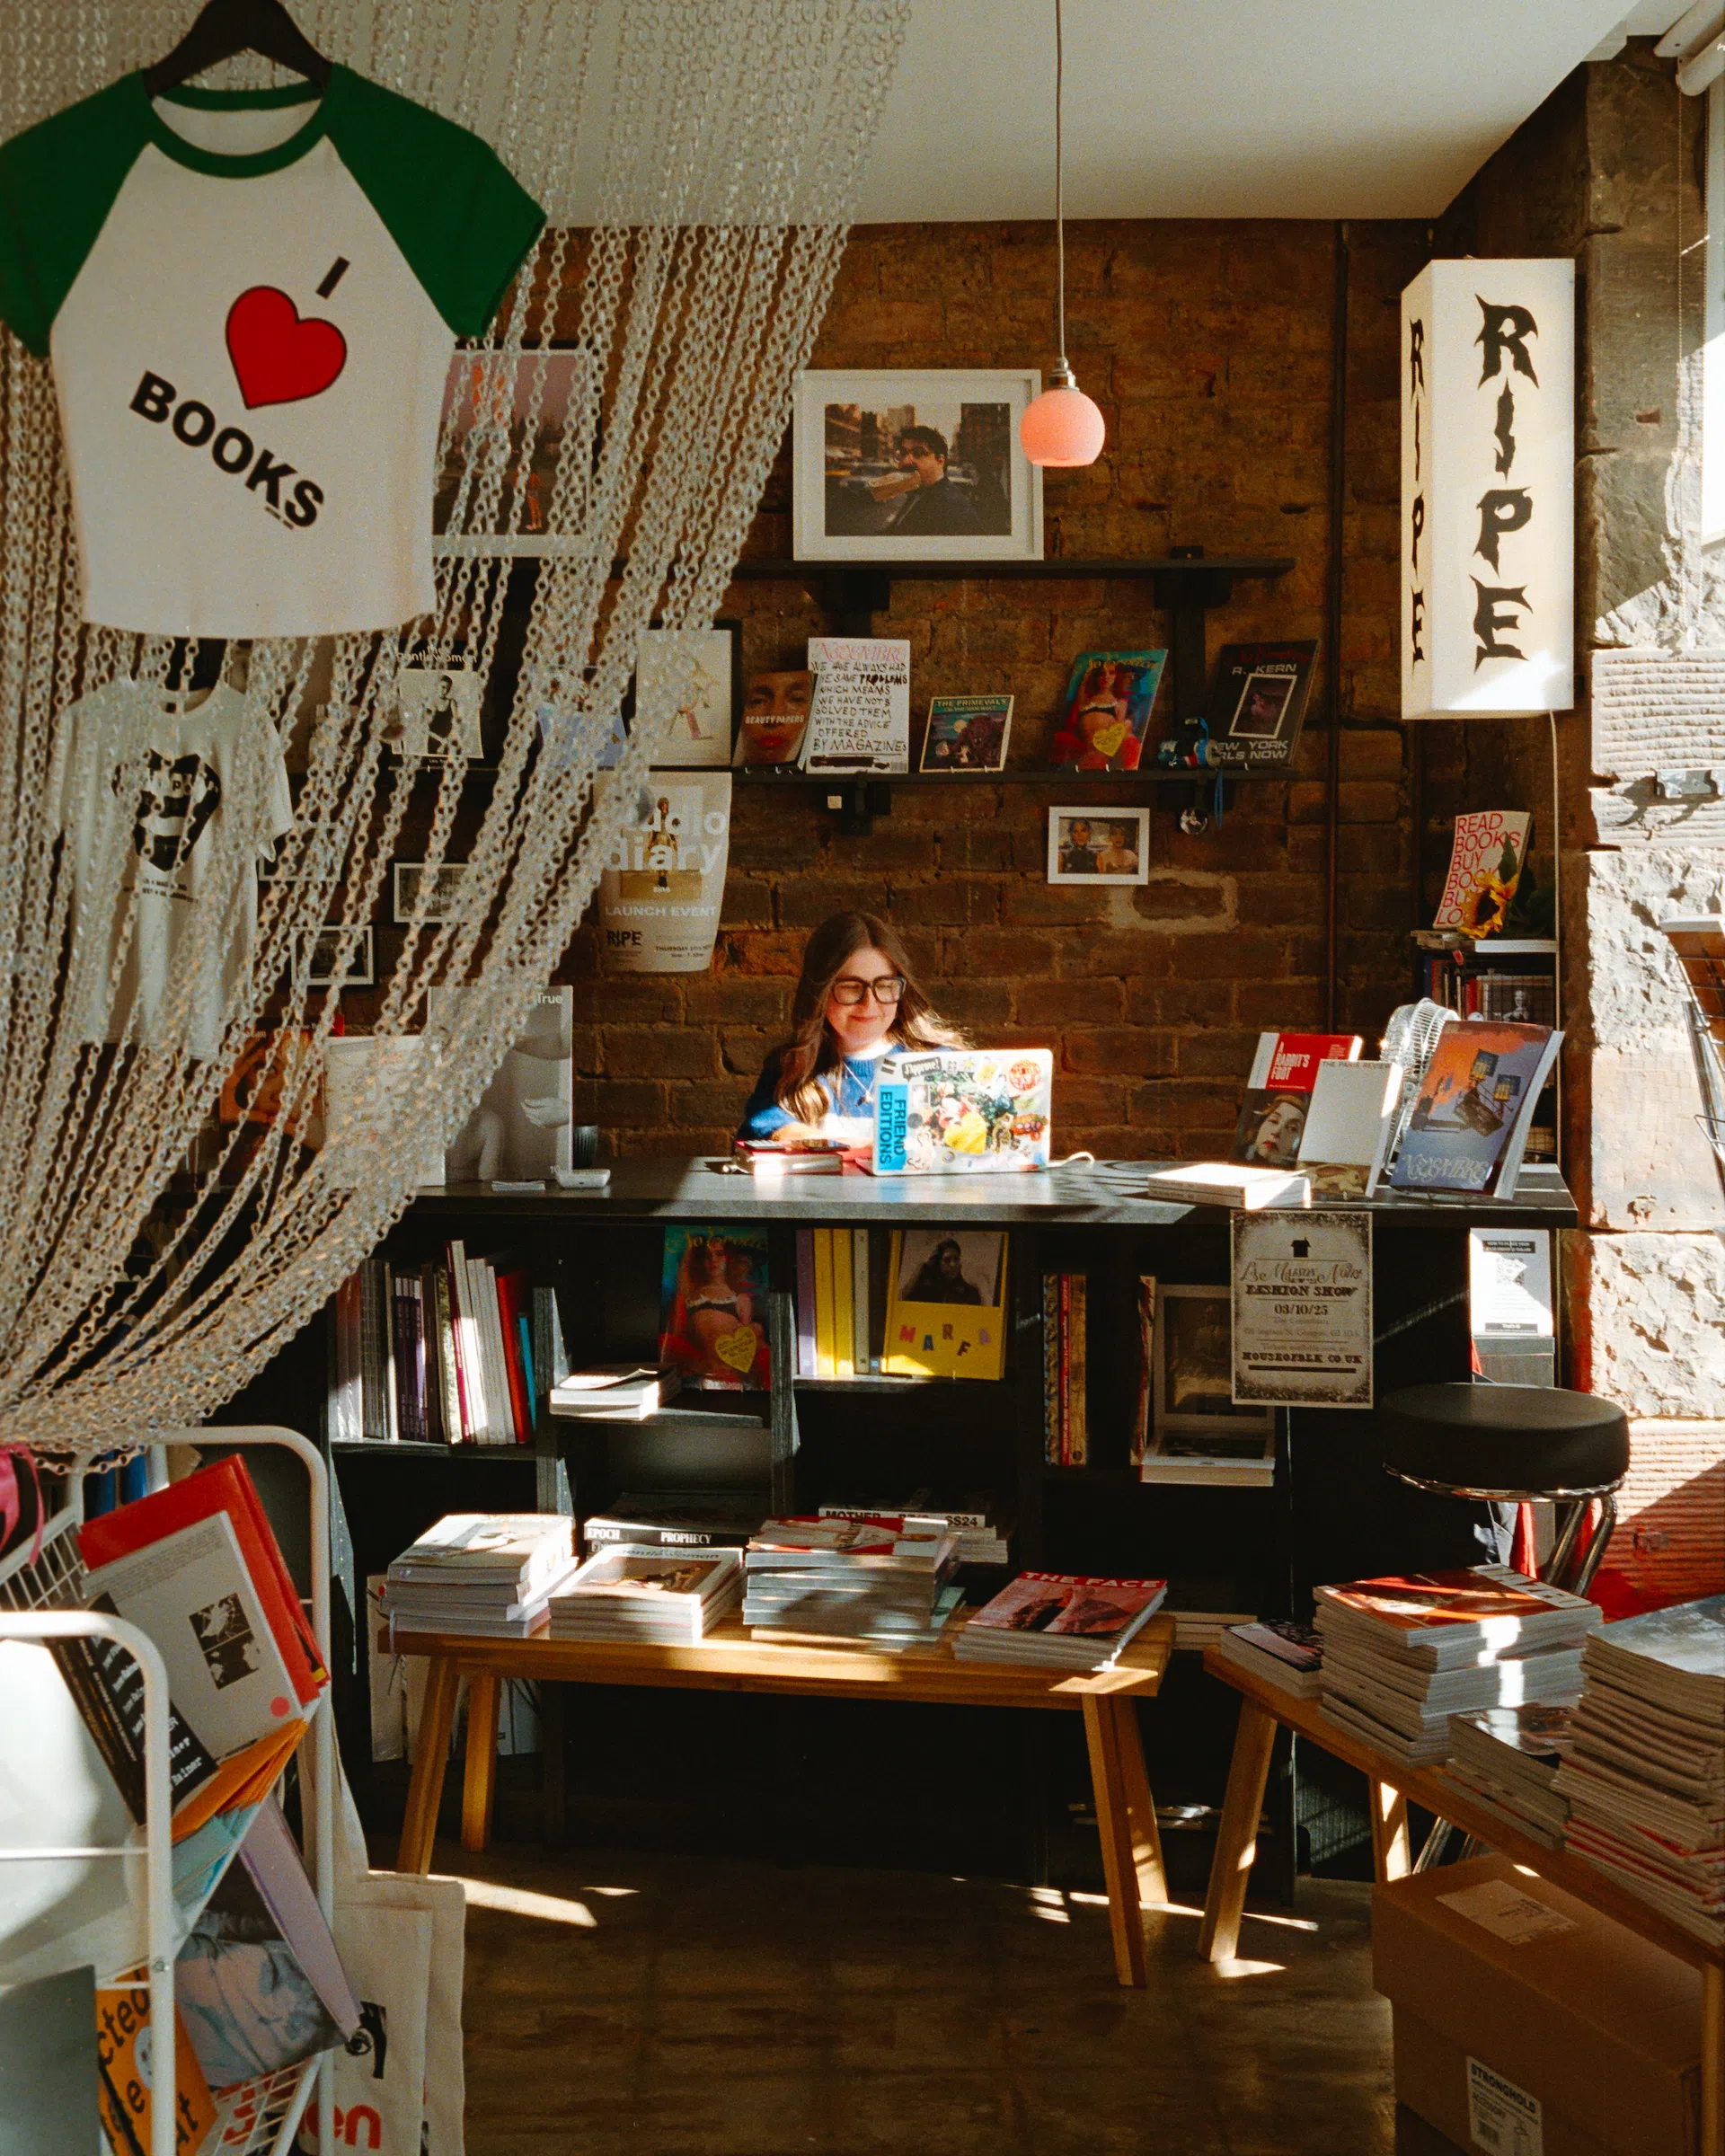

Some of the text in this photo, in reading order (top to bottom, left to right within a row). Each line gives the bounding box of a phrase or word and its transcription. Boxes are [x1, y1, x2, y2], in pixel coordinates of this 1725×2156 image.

[315, 256, 350, 299] I
[129, 370, 324, 528] BOOKS
[1469, 293, 1539, 675] RIPE
[1409, 316, 1427, 679] RIPE
[1255, 664, 1297, 674] KERN
[818, 696, 834, 705] WE
[837, 696, 863, 705] HAVE
[956, 698, 1007, 707] PRIMEVALS
[815, 706, 891, 719] SOLVED THEM
[815, 718, 835, 726] WITH
[838, 719, 854, 727] THE
[818, 729, 869, 738] OFFERED
[813, 738, 907, 752] BY MAGAZINES
[1248, 740, 1289, 750] YORK
[1249, 750, 1288, 760] NOW
[1456, 812, 1504, 835] READ
[1455, 831, 1522, 853] BOOKS
[1451, 851, 1483, 872] BUY
[605, 906, 717, 917] LAUNCH EVENT
[606, 928, 643, 946] RIPE
[1278, 1041, 1285, 1053] A
[1275, 1053, 1312, 1068] RABBIT'S
[1270, 1066, 1292, 1081] FOOT
[879, 1091, 892, 1164] EDITIONS
[894, 1100, 907, 1156] FRIEND
[1245, 1285, 1359, 1297] FASHION SHOW
[946, 1515, 978, 1526] SS24
[586, 1527, 712, 1544] EPOCH PROPHECY
[1025, 1572, 1161, 1588] THE FACE
